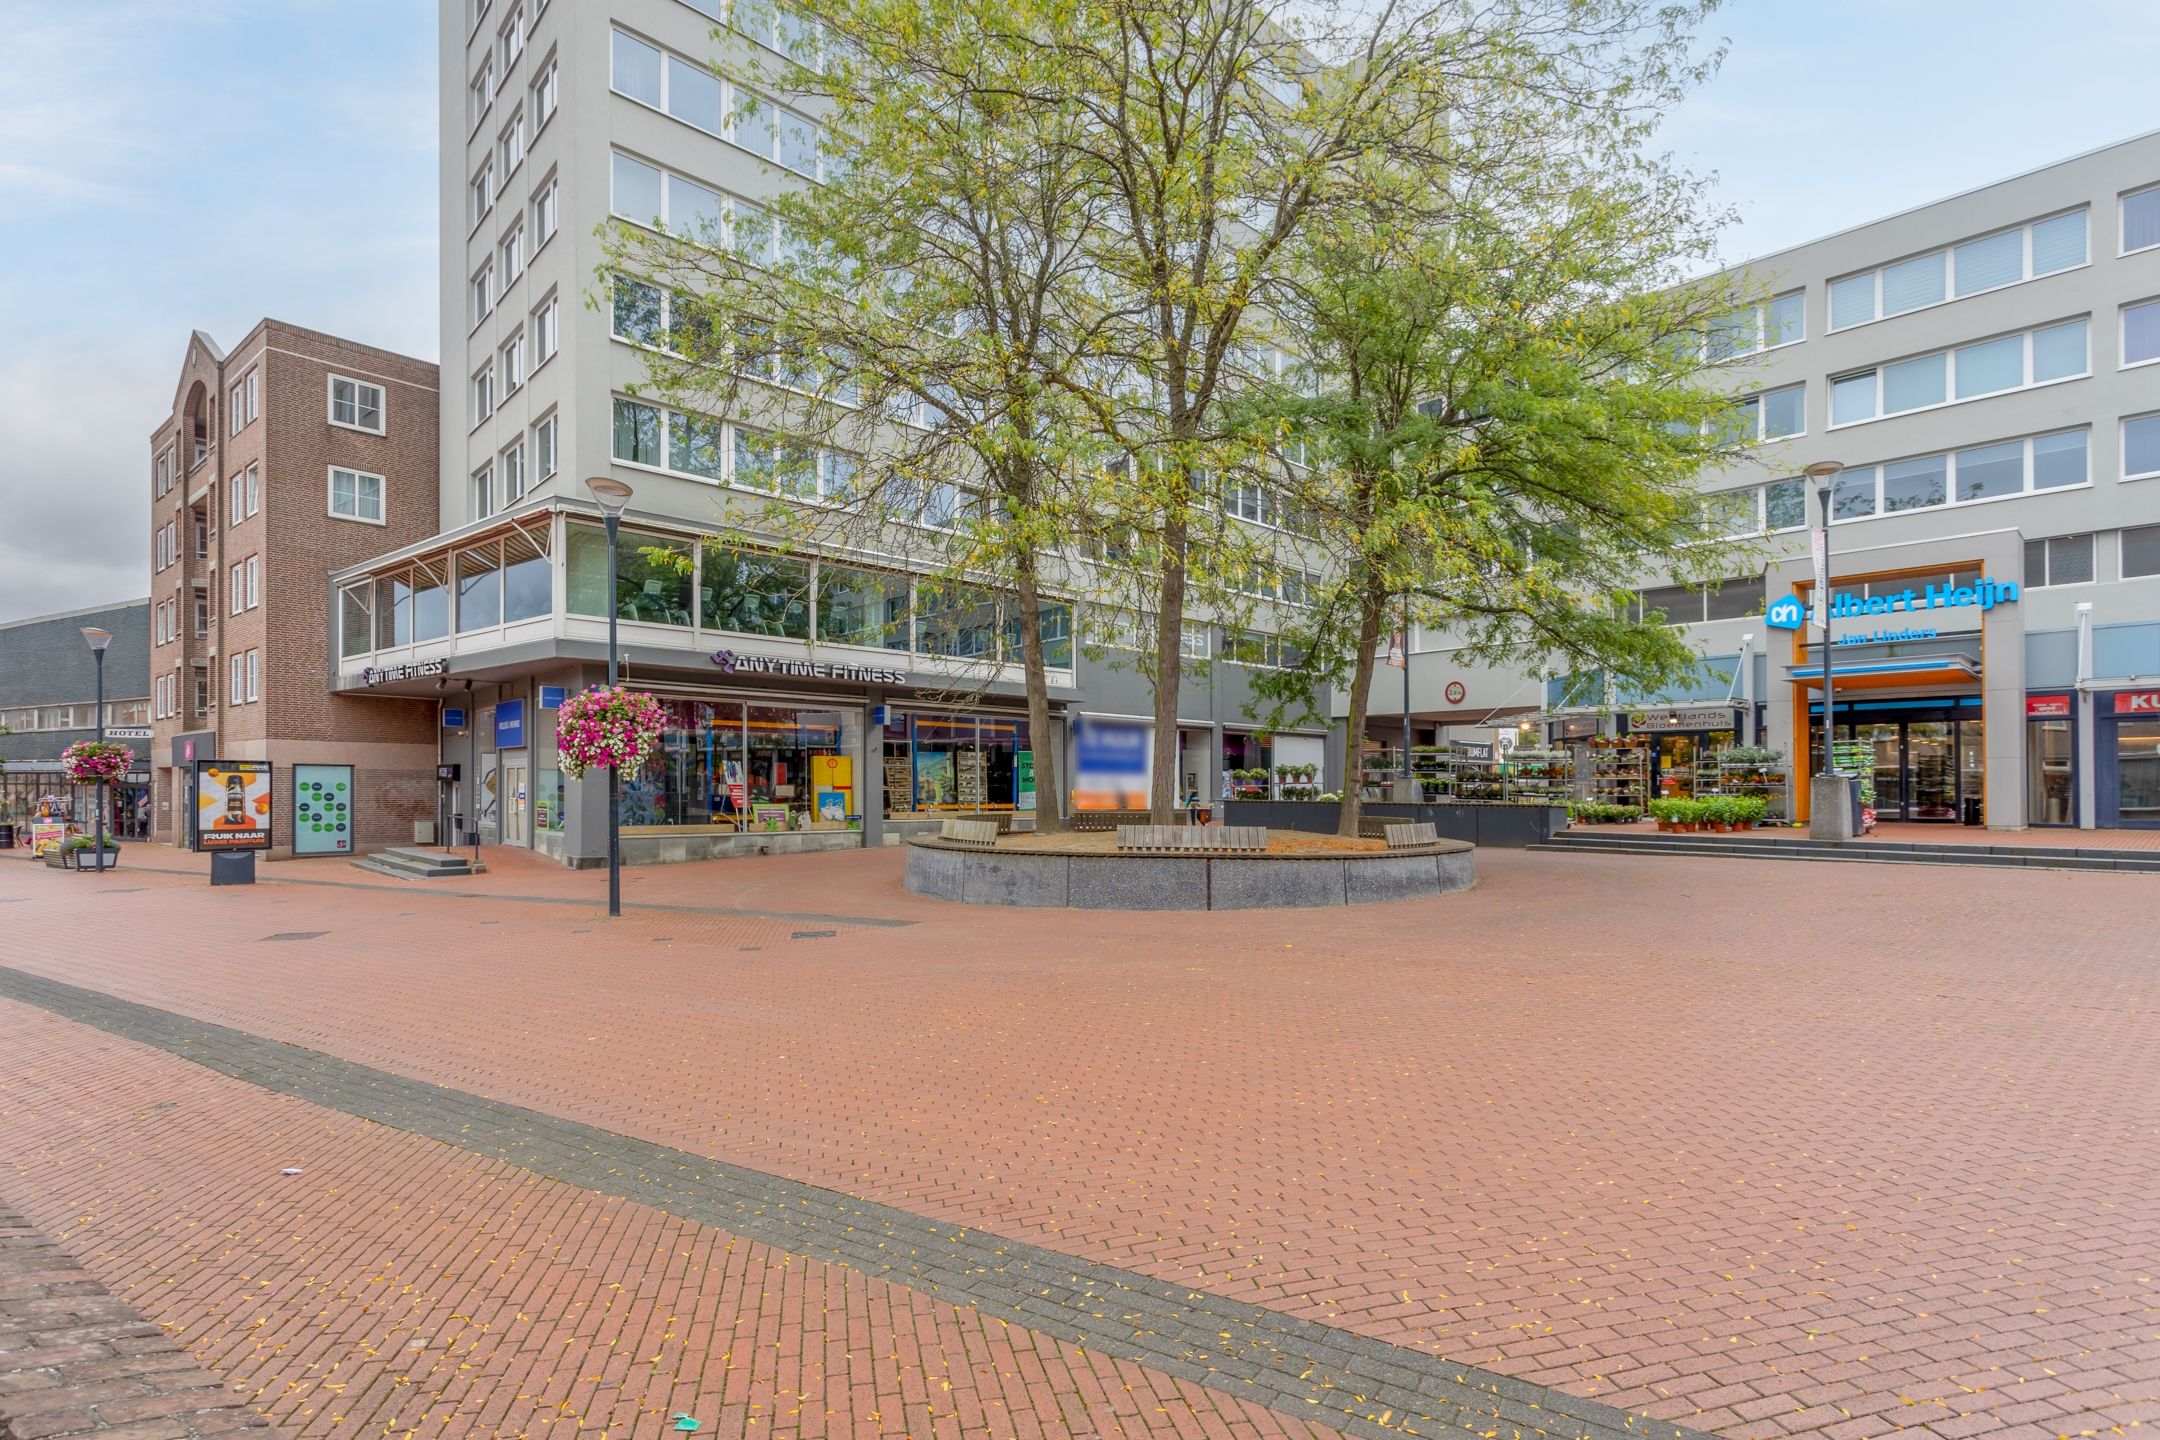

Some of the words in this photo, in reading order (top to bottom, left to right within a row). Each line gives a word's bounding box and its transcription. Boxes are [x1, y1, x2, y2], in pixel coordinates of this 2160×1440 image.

[1810, 588, 1916, 621] lbert
[1925, 577, 2018, 611] Heijn
[1837, 632, 1868, 646] Jan
[1873, 627, 1937, 643] Linders
[368, 665, 404, 684] ANYTIME
[405, 660, 442, 679] FITNESS
[735, 655, 826, 679] ANYTIME
[832, 664, 906, 684] FITNESS
[1647, 712, 1727, 722] Wetlands
[1647, 720, 1732, 729] Bloemenhuis
